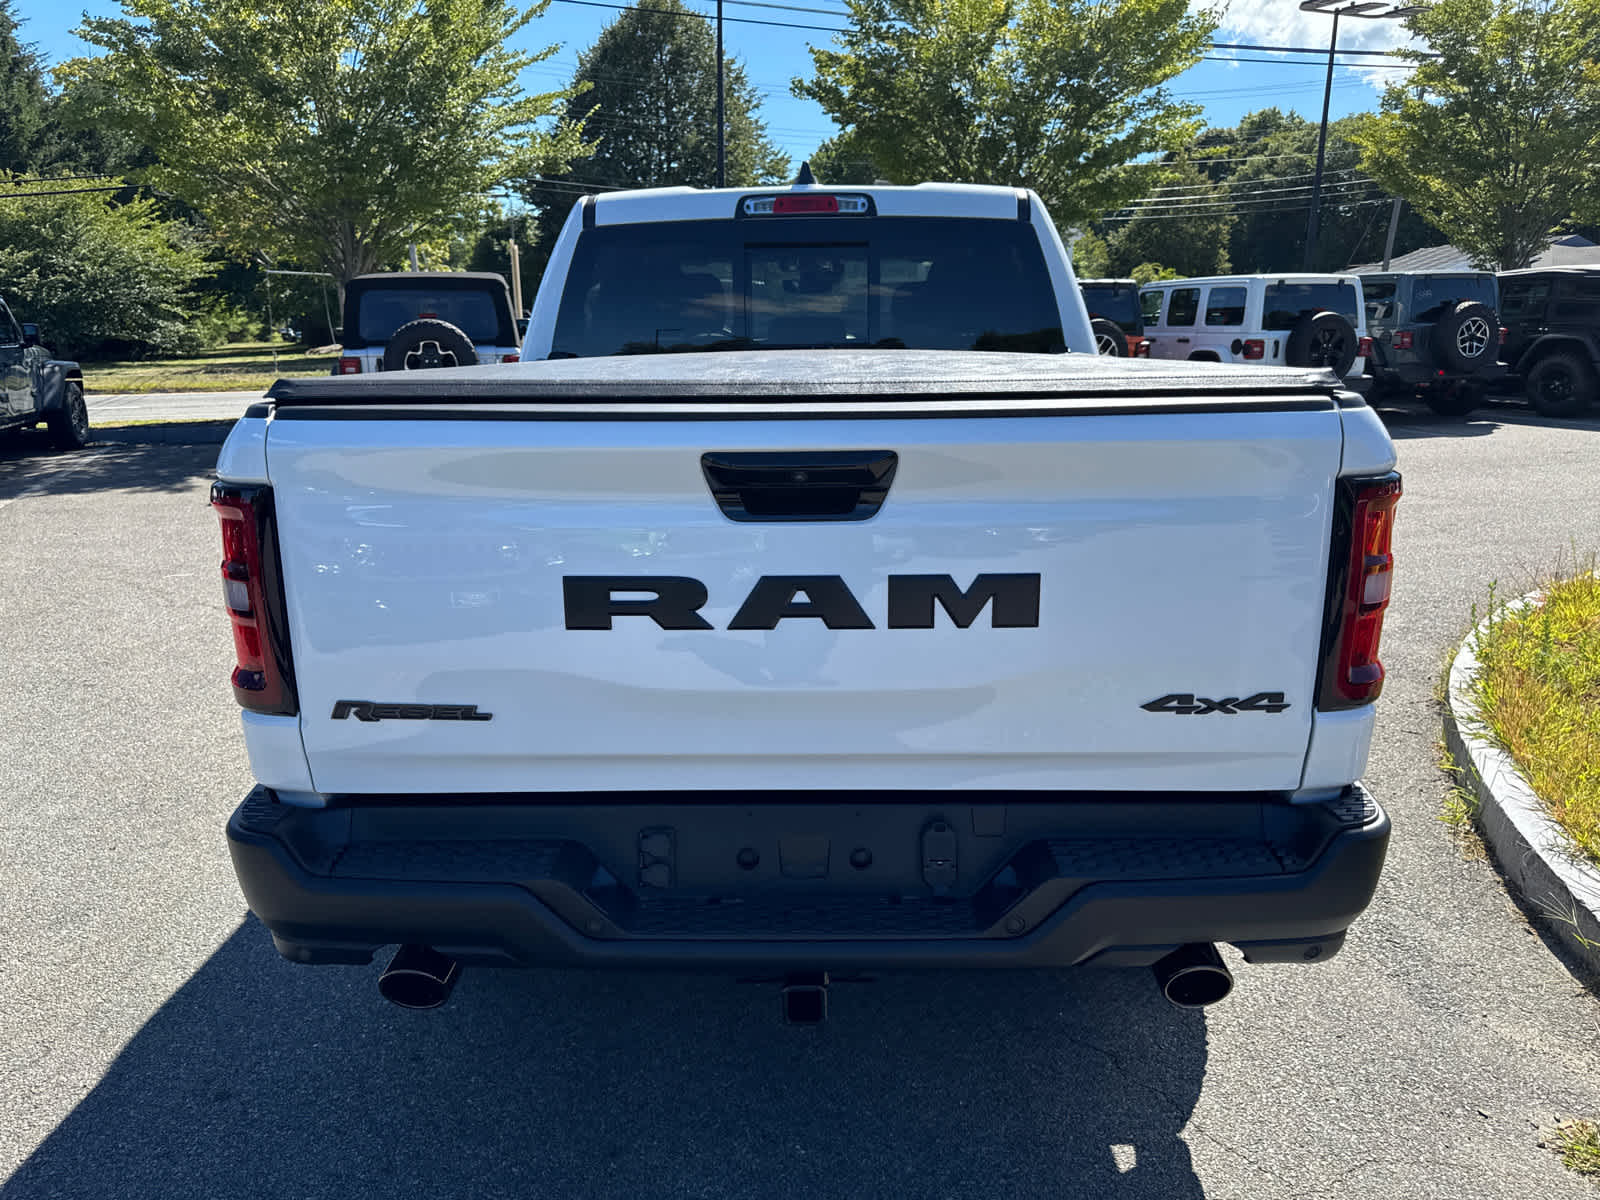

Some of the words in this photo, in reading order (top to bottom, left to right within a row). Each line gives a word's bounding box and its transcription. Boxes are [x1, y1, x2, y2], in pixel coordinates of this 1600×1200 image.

[562, 572, 1041, 630] RAM
[331, 700, 493, 722] REBEL
[1139, 691, 1291, 715] 4x4
